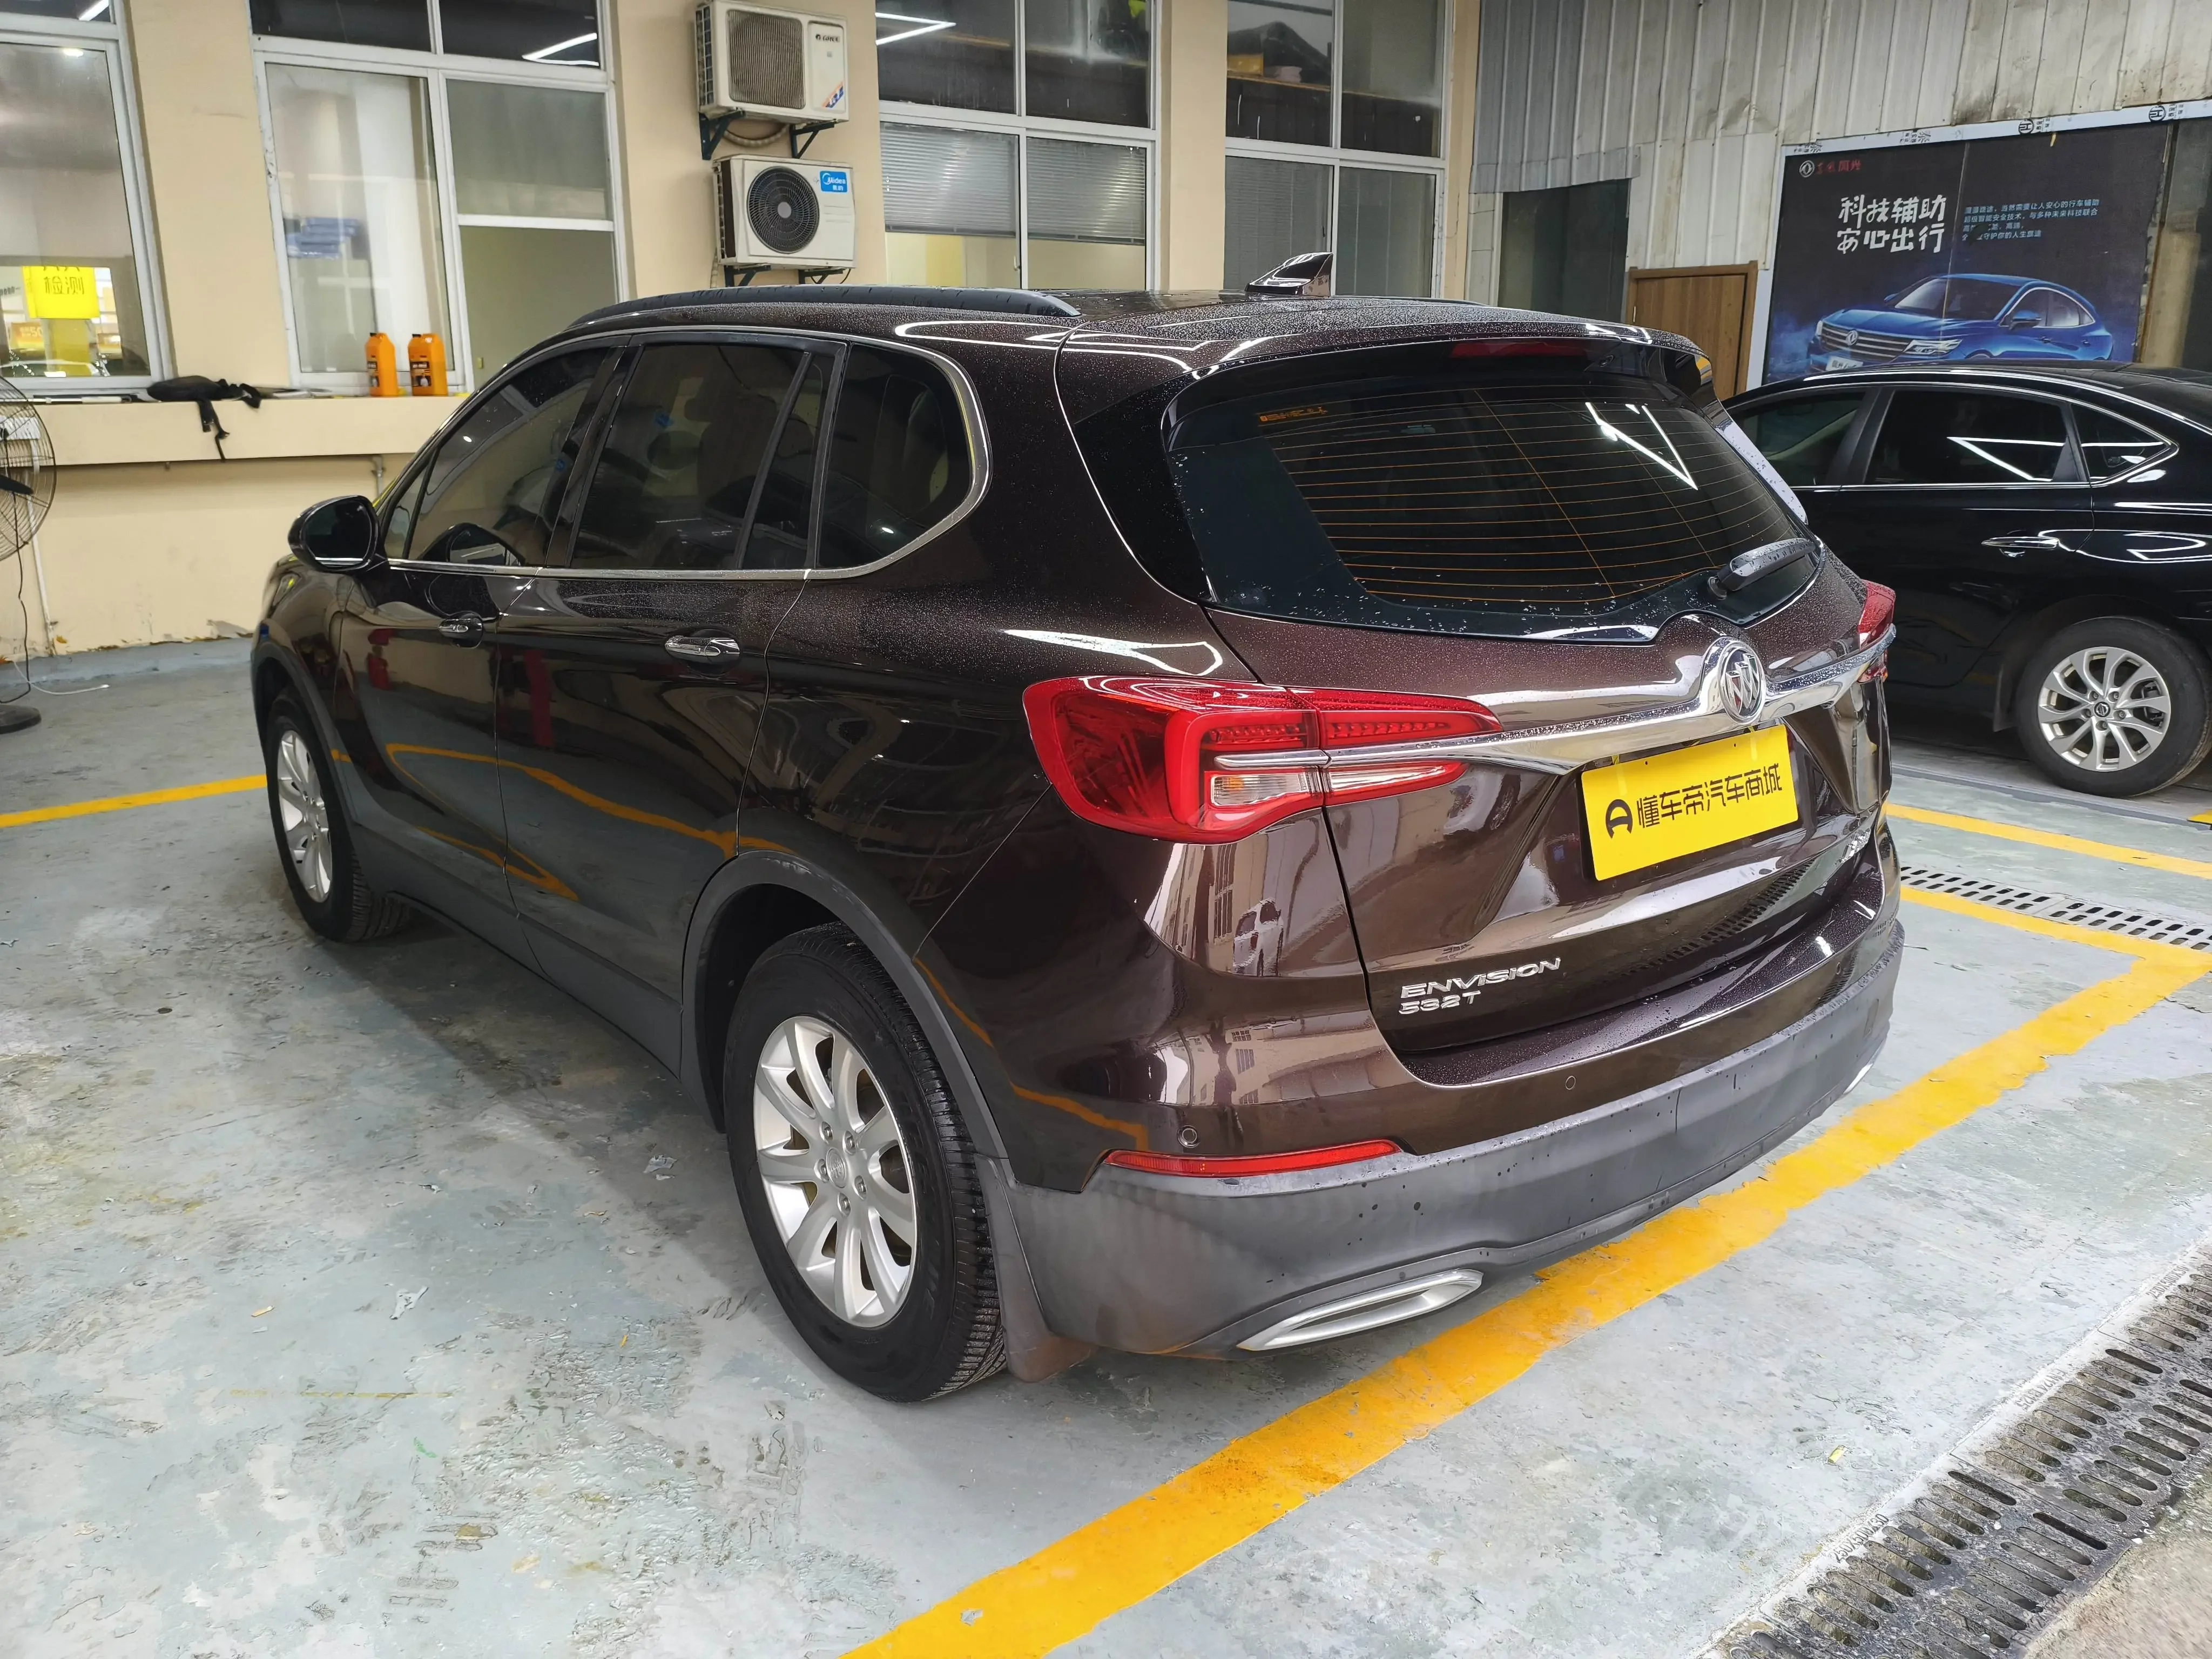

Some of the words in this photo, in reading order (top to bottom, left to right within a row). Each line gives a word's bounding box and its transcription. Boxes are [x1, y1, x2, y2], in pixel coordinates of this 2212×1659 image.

[823, 173, 846, 185] Midea
[1838, 194, 1946, 229] 科技辅助
[1837, 222, 1944, 254] 安心出行
[44, 276, 85, 294] 检测
[1636, 763, 1782, 828] 懂车帝汽车商城
[1401, 957, 1561, 998] ENVISION
